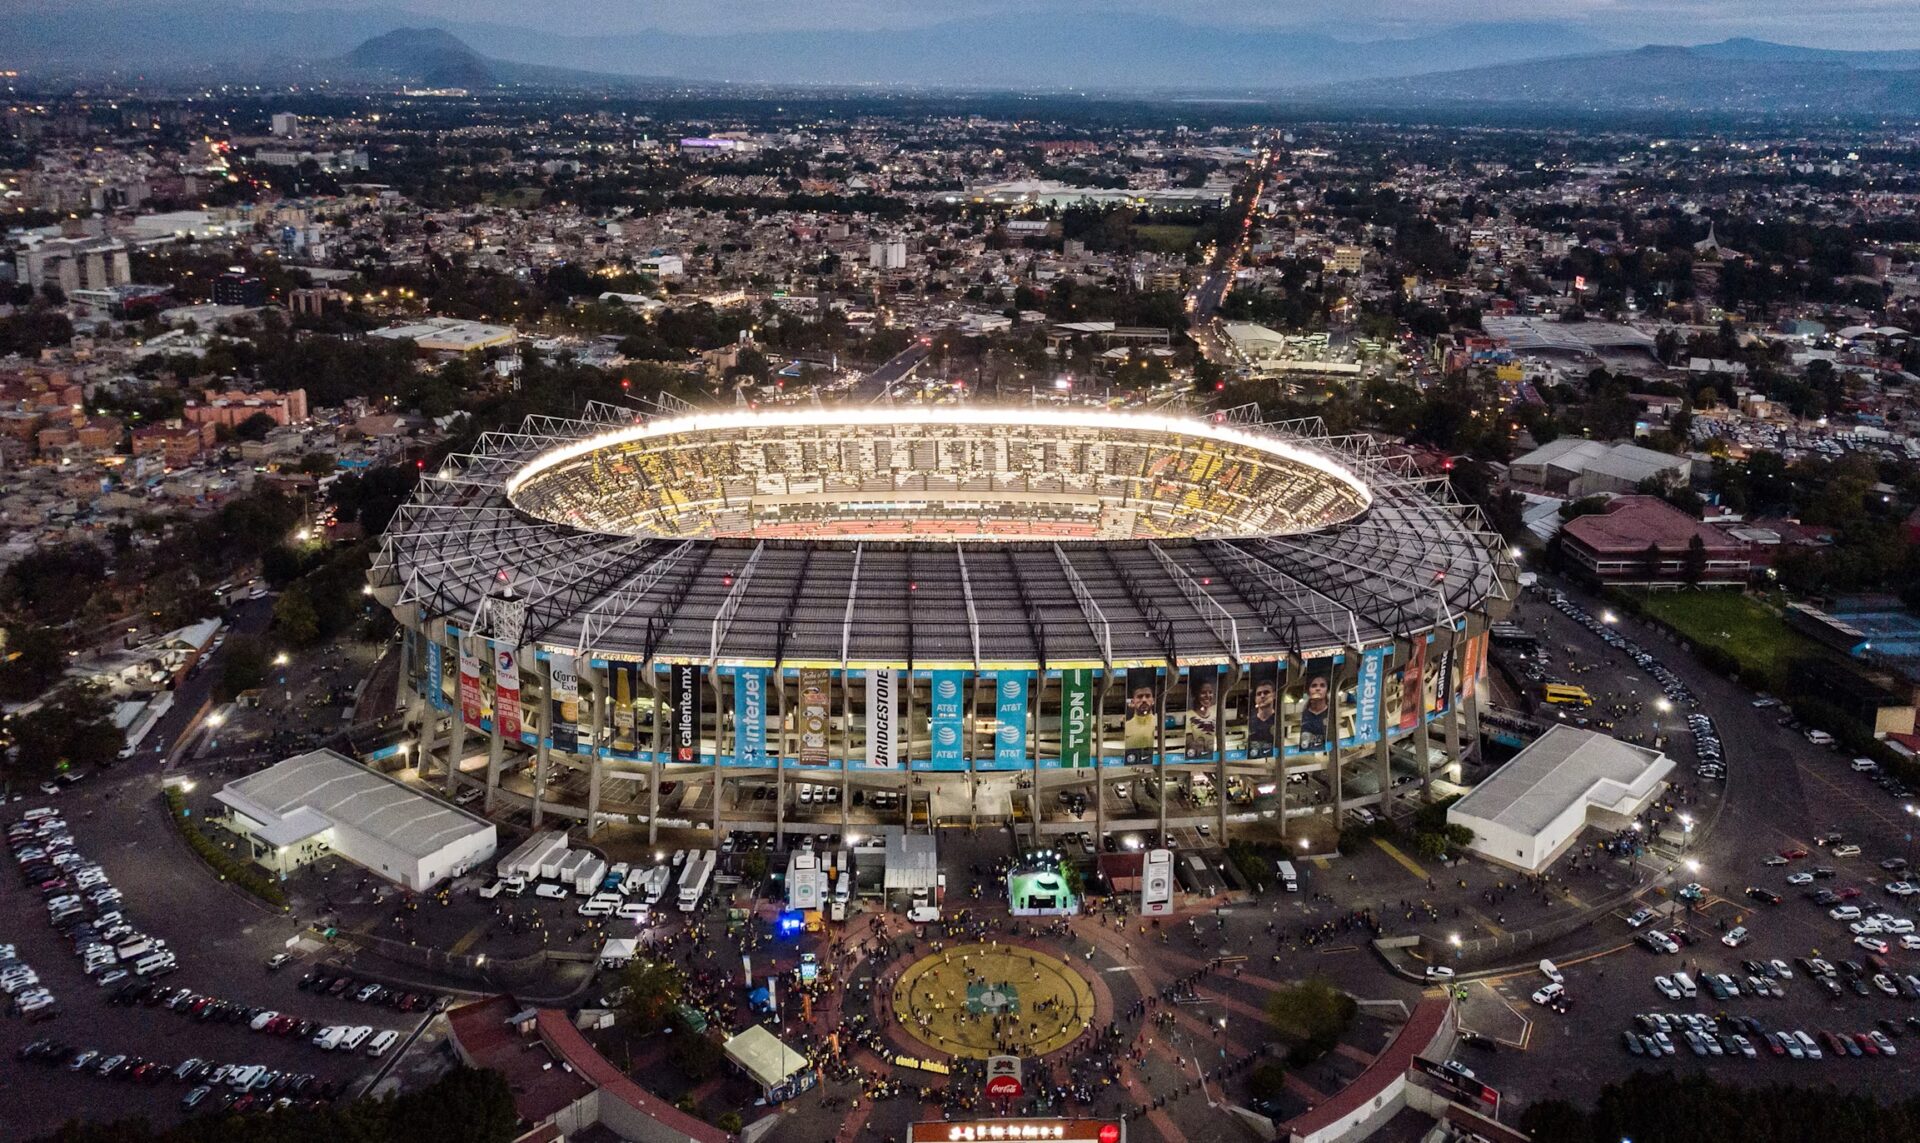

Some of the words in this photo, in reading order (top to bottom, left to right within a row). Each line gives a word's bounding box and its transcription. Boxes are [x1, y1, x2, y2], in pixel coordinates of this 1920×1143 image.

[497, 670, 518, 681] TOTAL
[552, 669, 577, 684] Coro
[679, 667, 692, 747] caliente.mx
[936, 703, 958, 713] AT&T
[1000, 703, 1022, 713] AT&T
[875, 670, 889, 767] BRIDGESTONE
[1069, 691, 1085, 748] TUDN
[935, 750, 958, 759] AT&T
[999, 749, 1021, 758] AT&T
